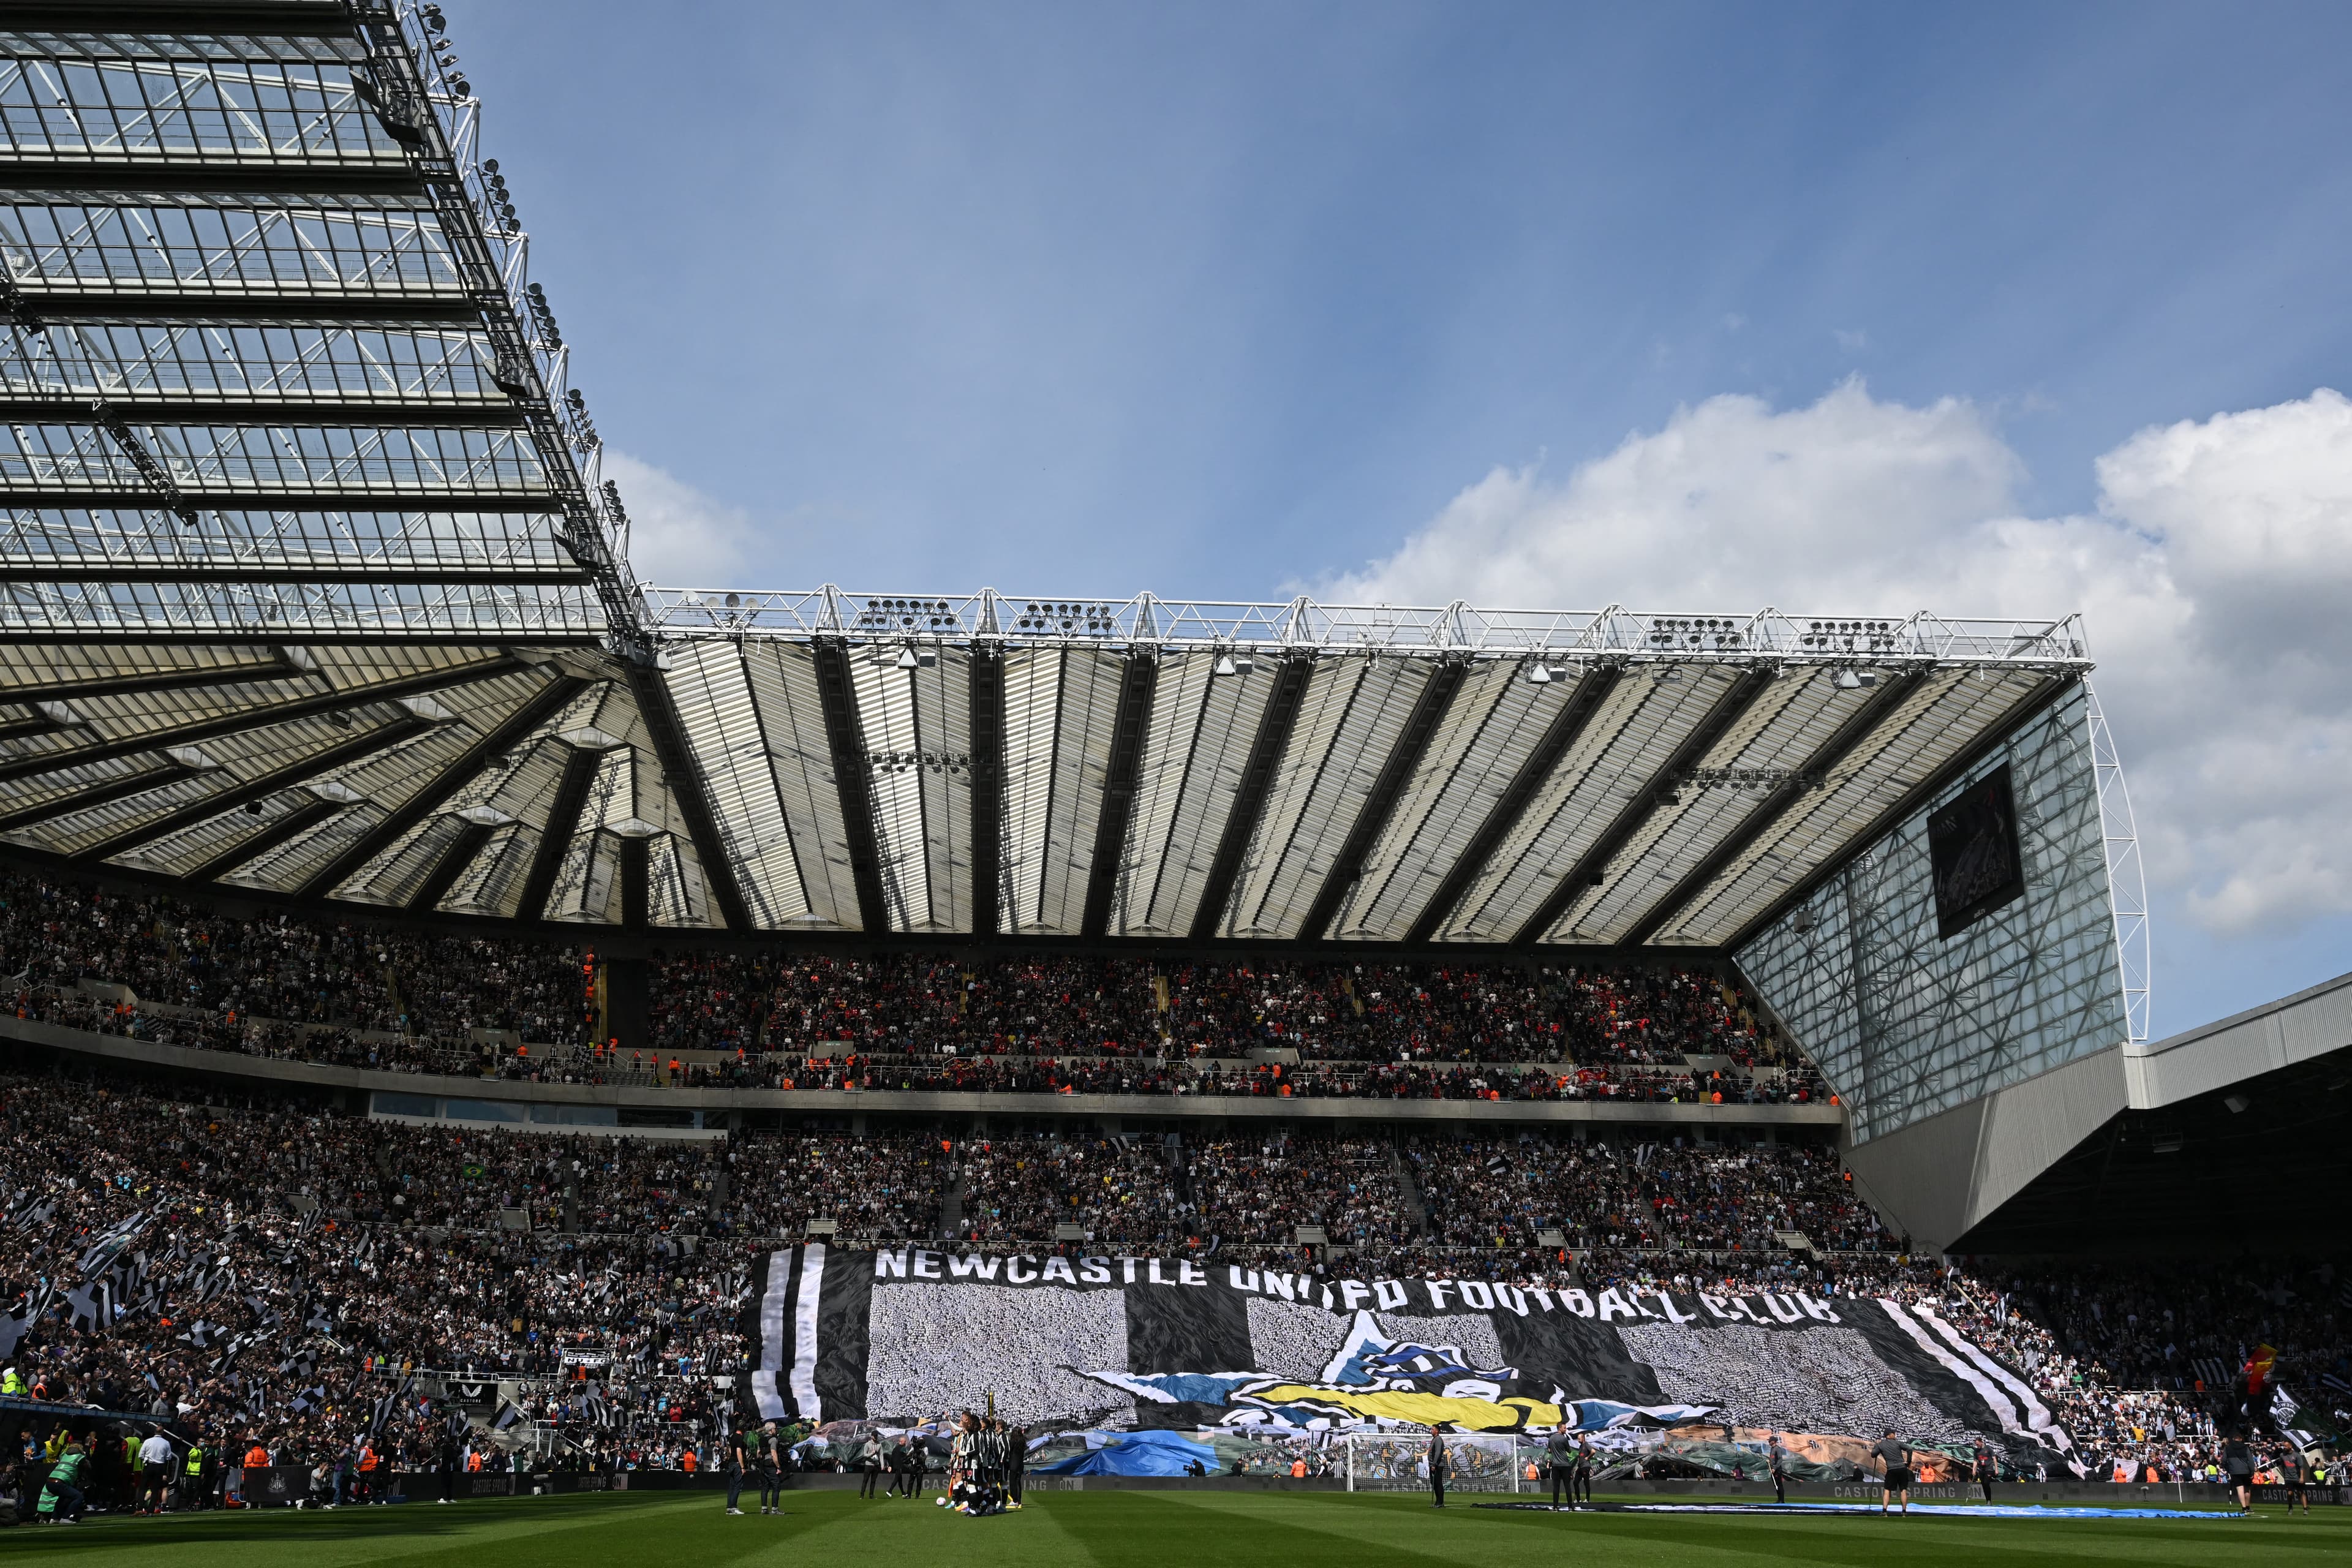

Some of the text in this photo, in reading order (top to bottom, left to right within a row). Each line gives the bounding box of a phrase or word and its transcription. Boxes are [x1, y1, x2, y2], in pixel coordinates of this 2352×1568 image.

[875, 1249, 1842, 1324] NEWCASTLE UNITED FOOTBALL CLUB
[1907, 1487, 1955, 1498] SPRING
